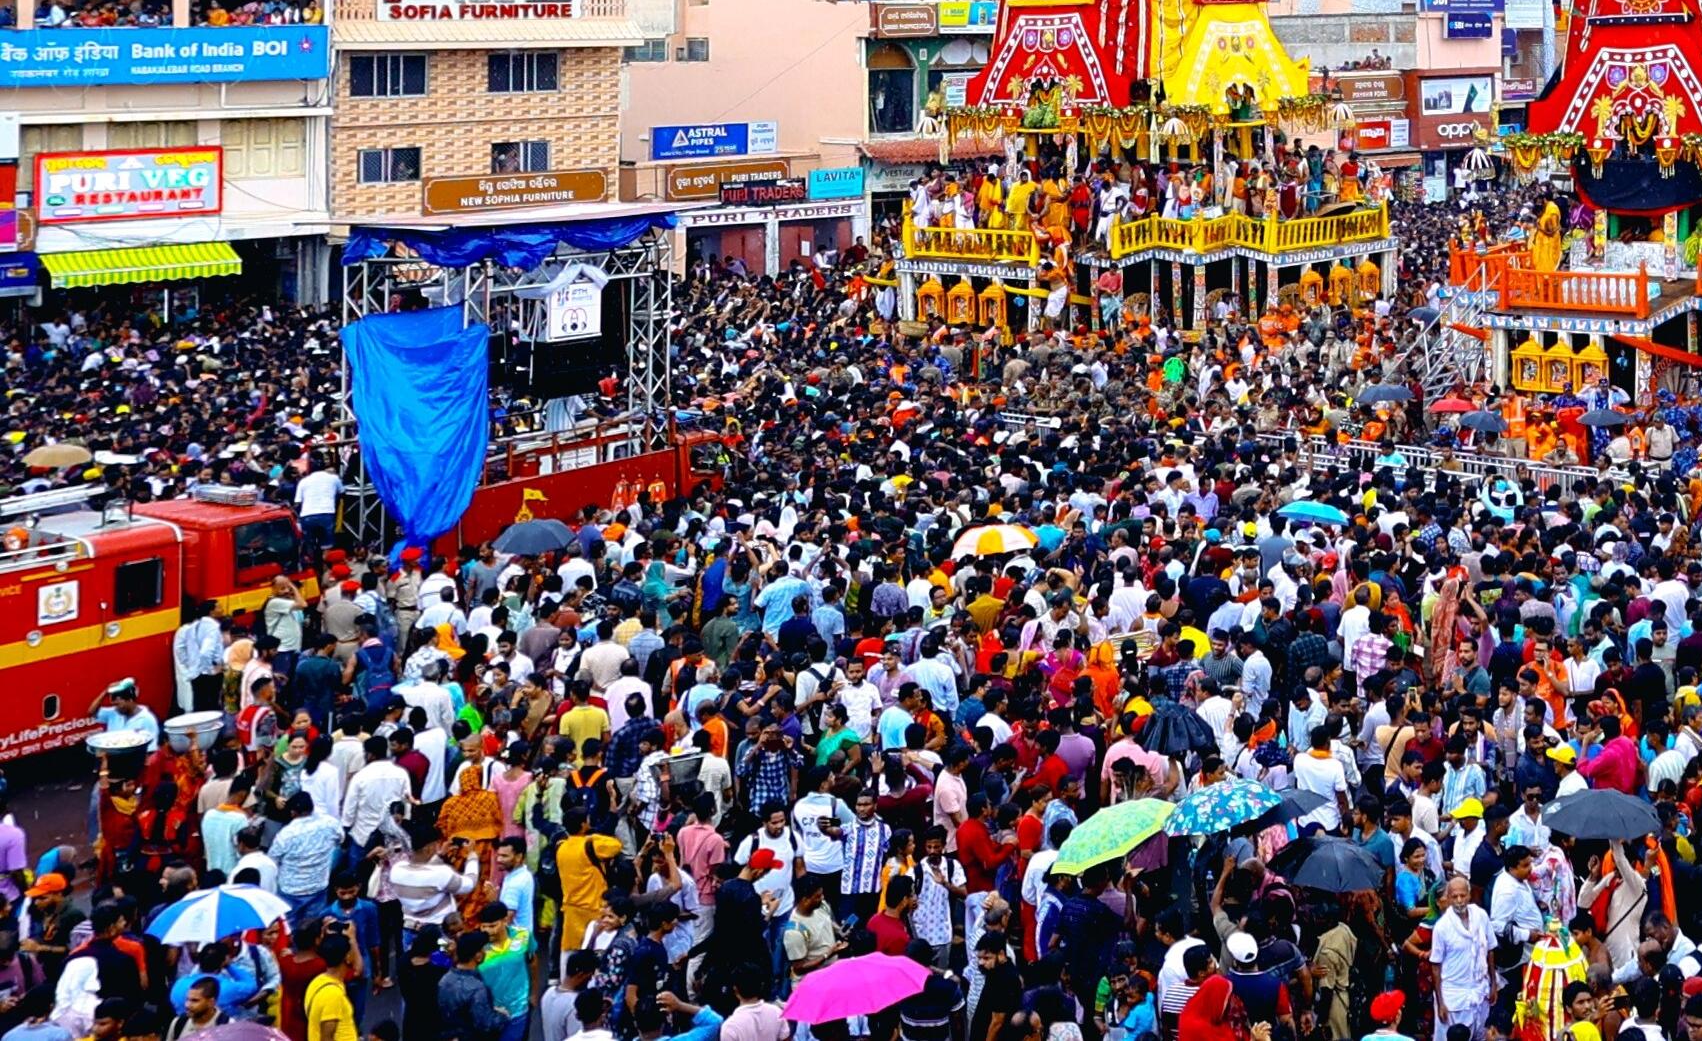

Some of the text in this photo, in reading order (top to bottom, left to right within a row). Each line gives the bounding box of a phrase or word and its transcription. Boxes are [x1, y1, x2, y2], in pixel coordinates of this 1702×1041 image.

[389, 4, 572, 19] SOFIA FURNITURE
[131, 41, 288, 58] Bank of India BOI
[687, 126, 727, 138] ASTRAL
[691, 137, 714, 146] PIPES
[49, 168, 209, 193] PURI VEG
[731, 170, 782, 182] PURI TRADERS
[816, 169, 856, 182] LAVITA
[74, 188, 203, 206] RESTAURANT
[461, 190, 574, 207] NEW SOPHIA FURNITURE
[722, 185, 804, 203] PURI TRADERS
[692, 205, 851, 225] PURI TRADERS
[0, 717, 97, 750] yLifePreciou
